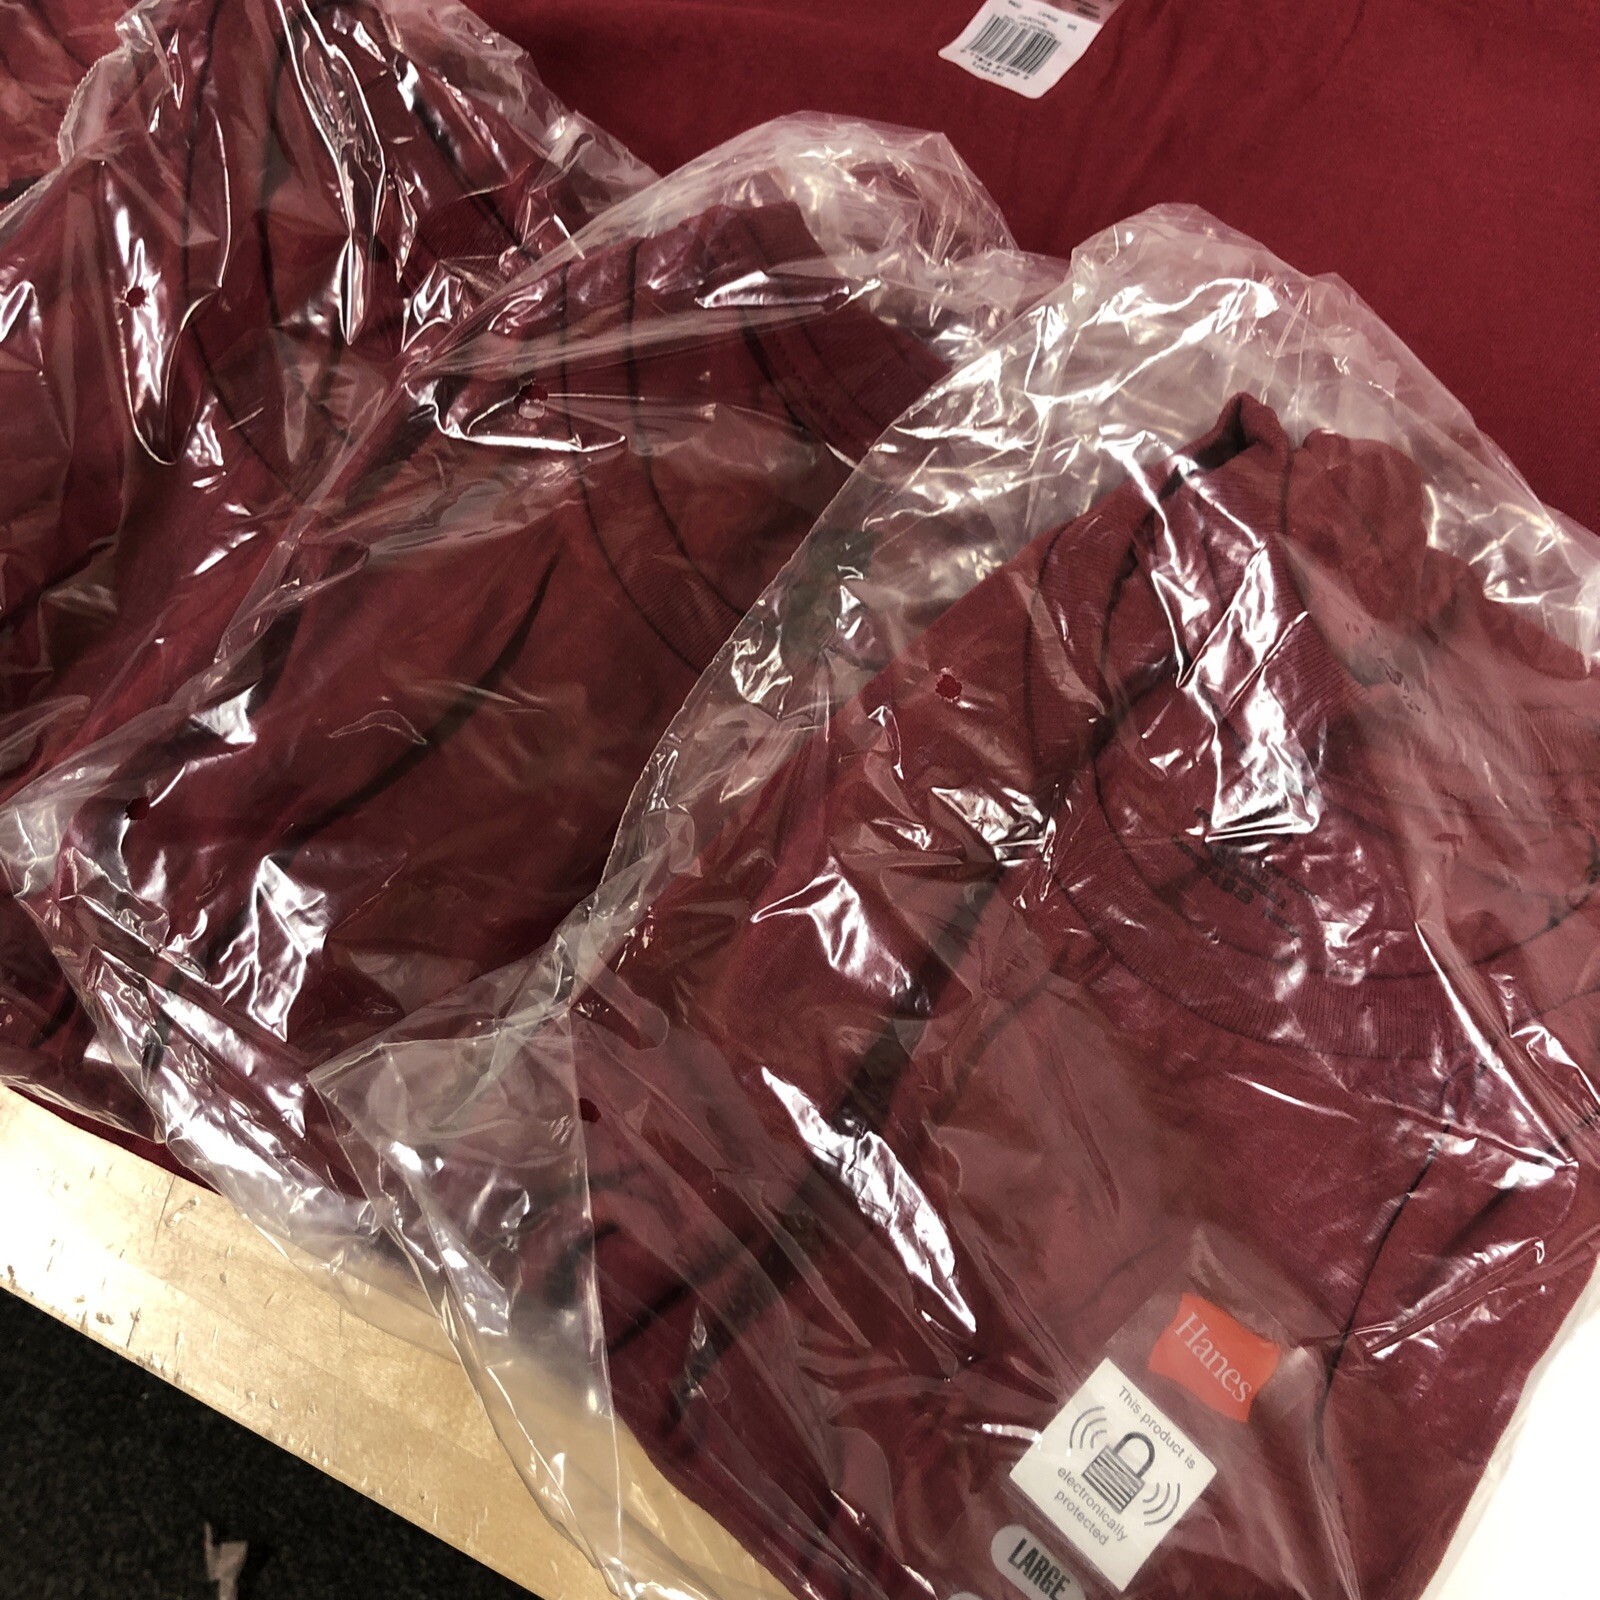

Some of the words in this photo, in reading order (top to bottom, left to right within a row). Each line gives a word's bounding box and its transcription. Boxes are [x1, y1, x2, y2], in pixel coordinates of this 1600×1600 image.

[1174, 1312, 1252, 1403] Hanes
[1117, 1386, 1142, 1415] This
[1140, 1412, 1186, 1458] product
[1184, 1453, 1196, 1470] is
[1054, 1490, 1110, 1546] protected
[1057, 1467, 1128, 1542] electronically
[1007, 1537, 1071, 1600] LARGE
